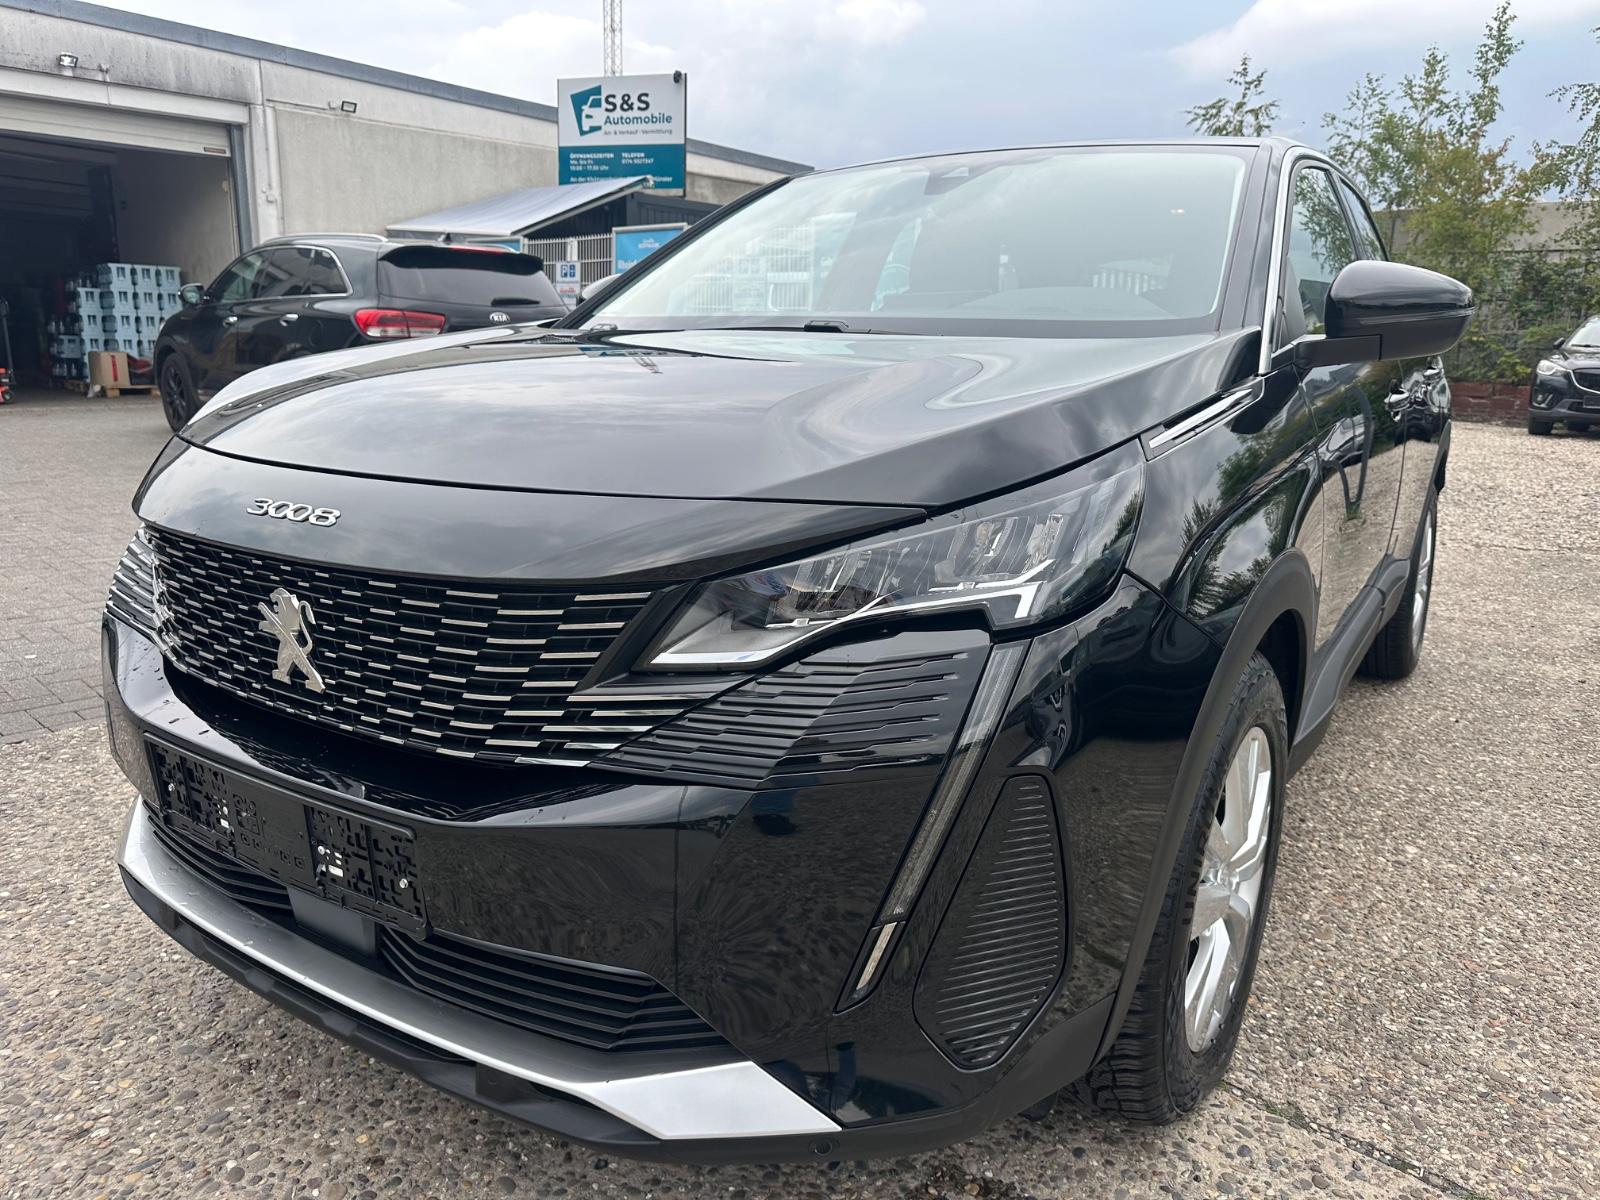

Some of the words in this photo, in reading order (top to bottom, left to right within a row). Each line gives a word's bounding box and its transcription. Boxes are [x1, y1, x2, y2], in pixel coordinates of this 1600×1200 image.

[604, 93, 650, 112] S&S
[604, 112, 672, 126] Automobile
[246, 498, 342, 527] 3008
